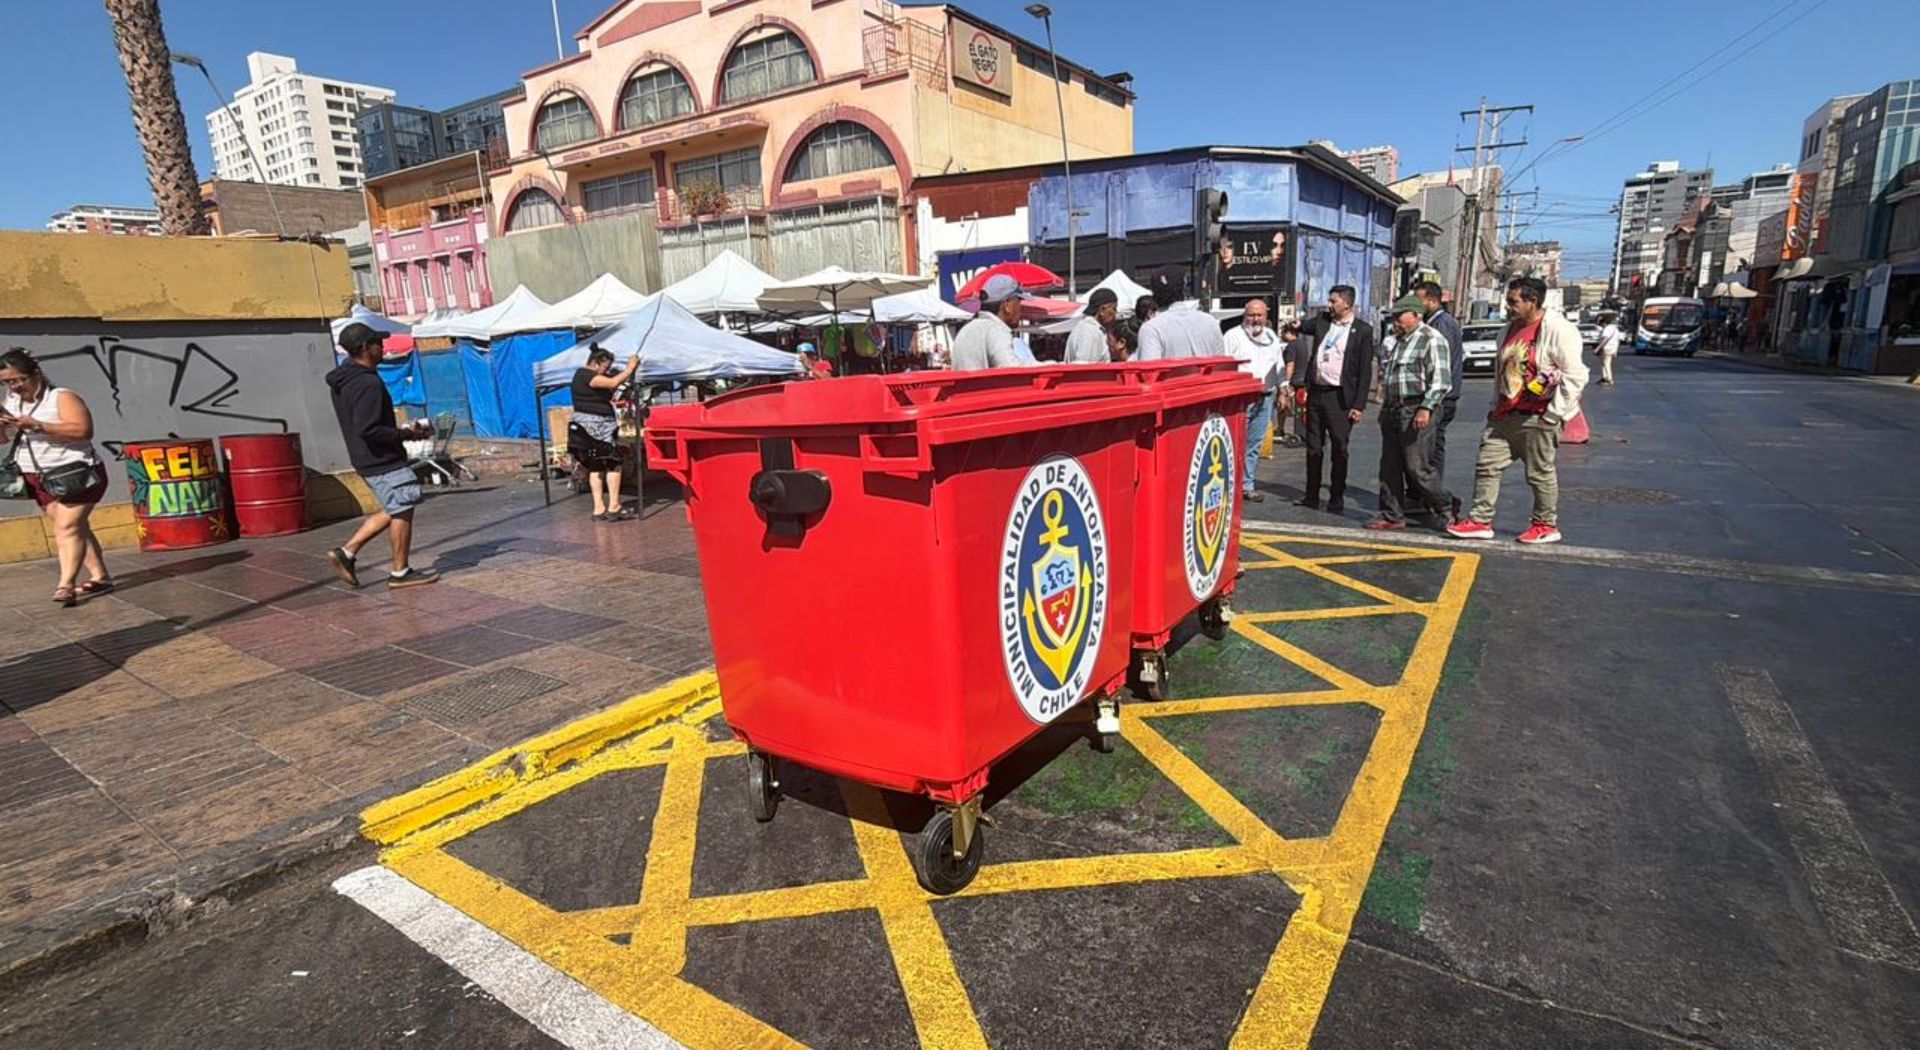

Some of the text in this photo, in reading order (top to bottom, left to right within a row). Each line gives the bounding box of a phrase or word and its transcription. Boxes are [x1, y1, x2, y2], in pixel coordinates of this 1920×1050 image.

[978, 45, 998, 60] GATO
[971, 58, 997, 73] NEGRO
[1232, 255, 1272, 265] ESTILO VIP
[1211, 419, 1221, 432] DE
[1004, 464, 1105, 700] MUNICIPALIDAD DE ANTOFAGASTA
[1039, 671, 1084, 714] CHILE
